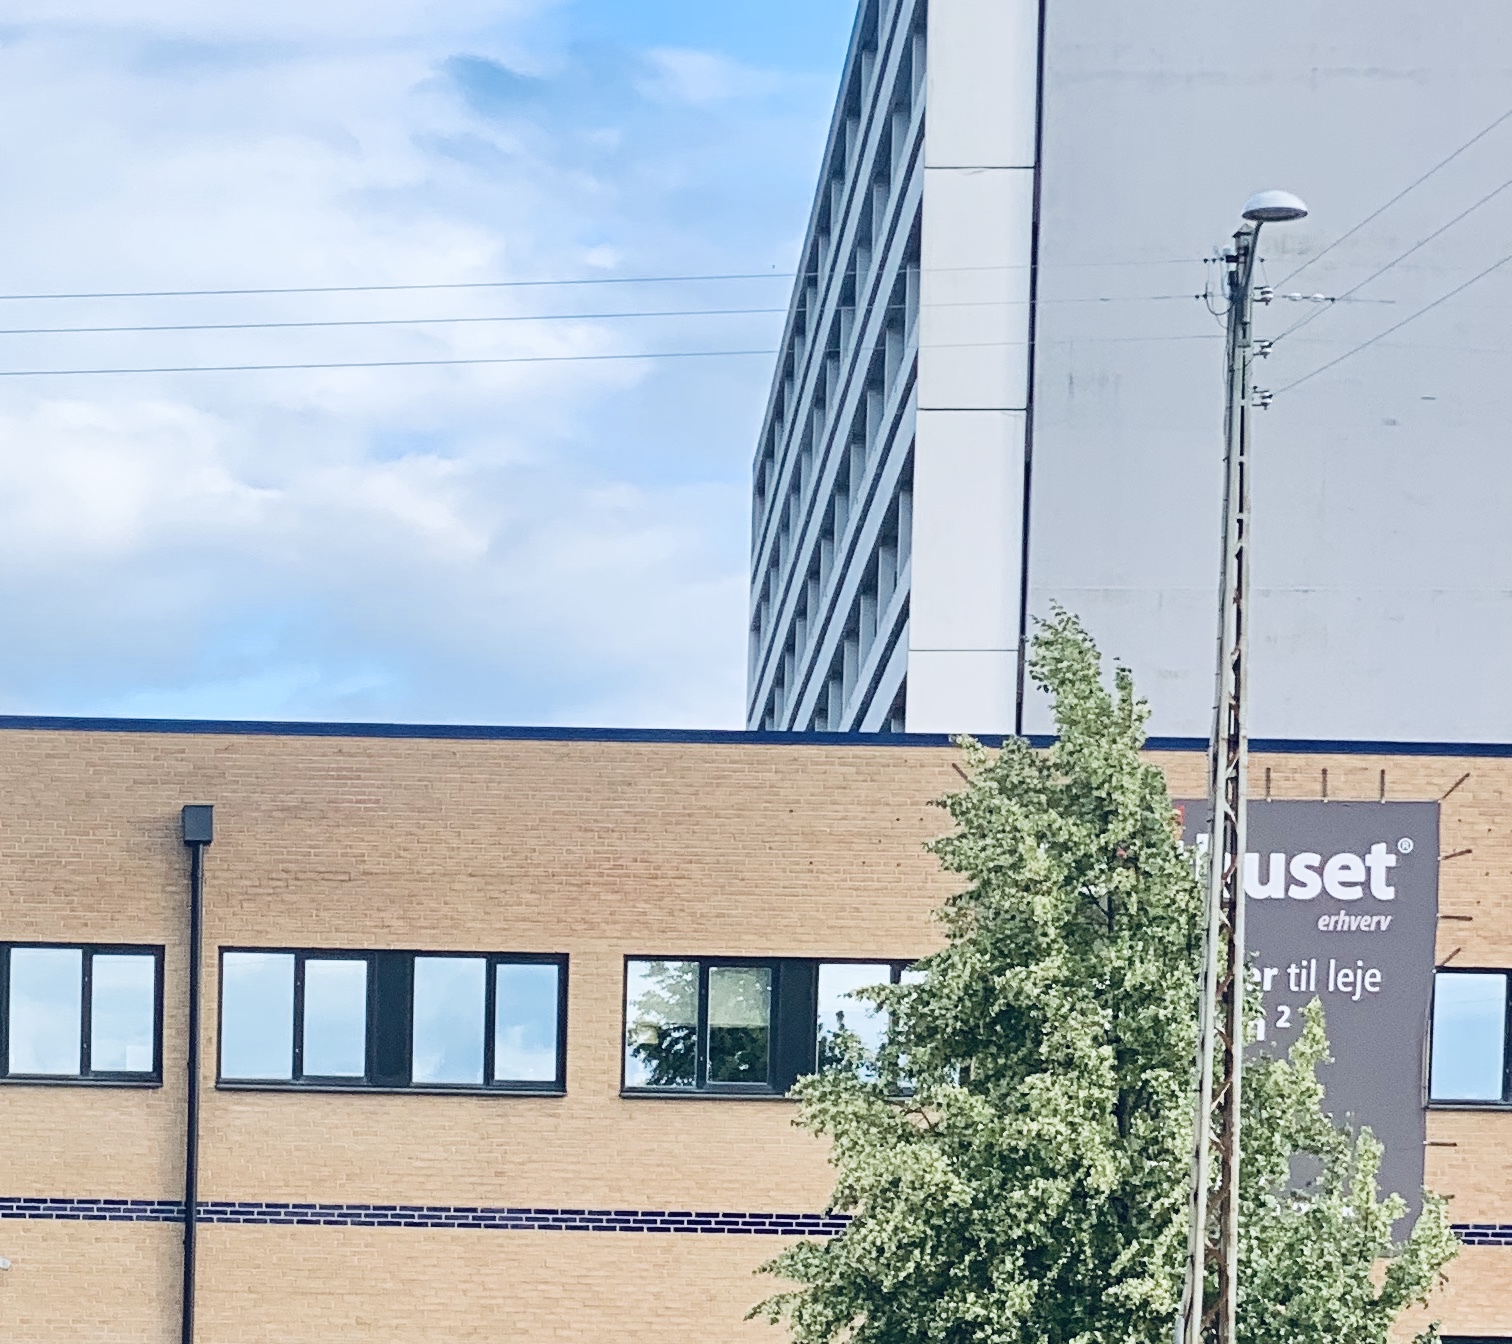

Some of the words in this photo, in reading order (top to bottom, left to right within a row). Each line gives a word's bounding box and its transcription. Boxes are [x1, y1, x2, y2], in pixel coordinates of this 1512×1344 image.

[1317, 909, 1393, 931] erhverv
[1287, 958, 1317, 992] til
[1328, 958, 1382, 1001] leje
